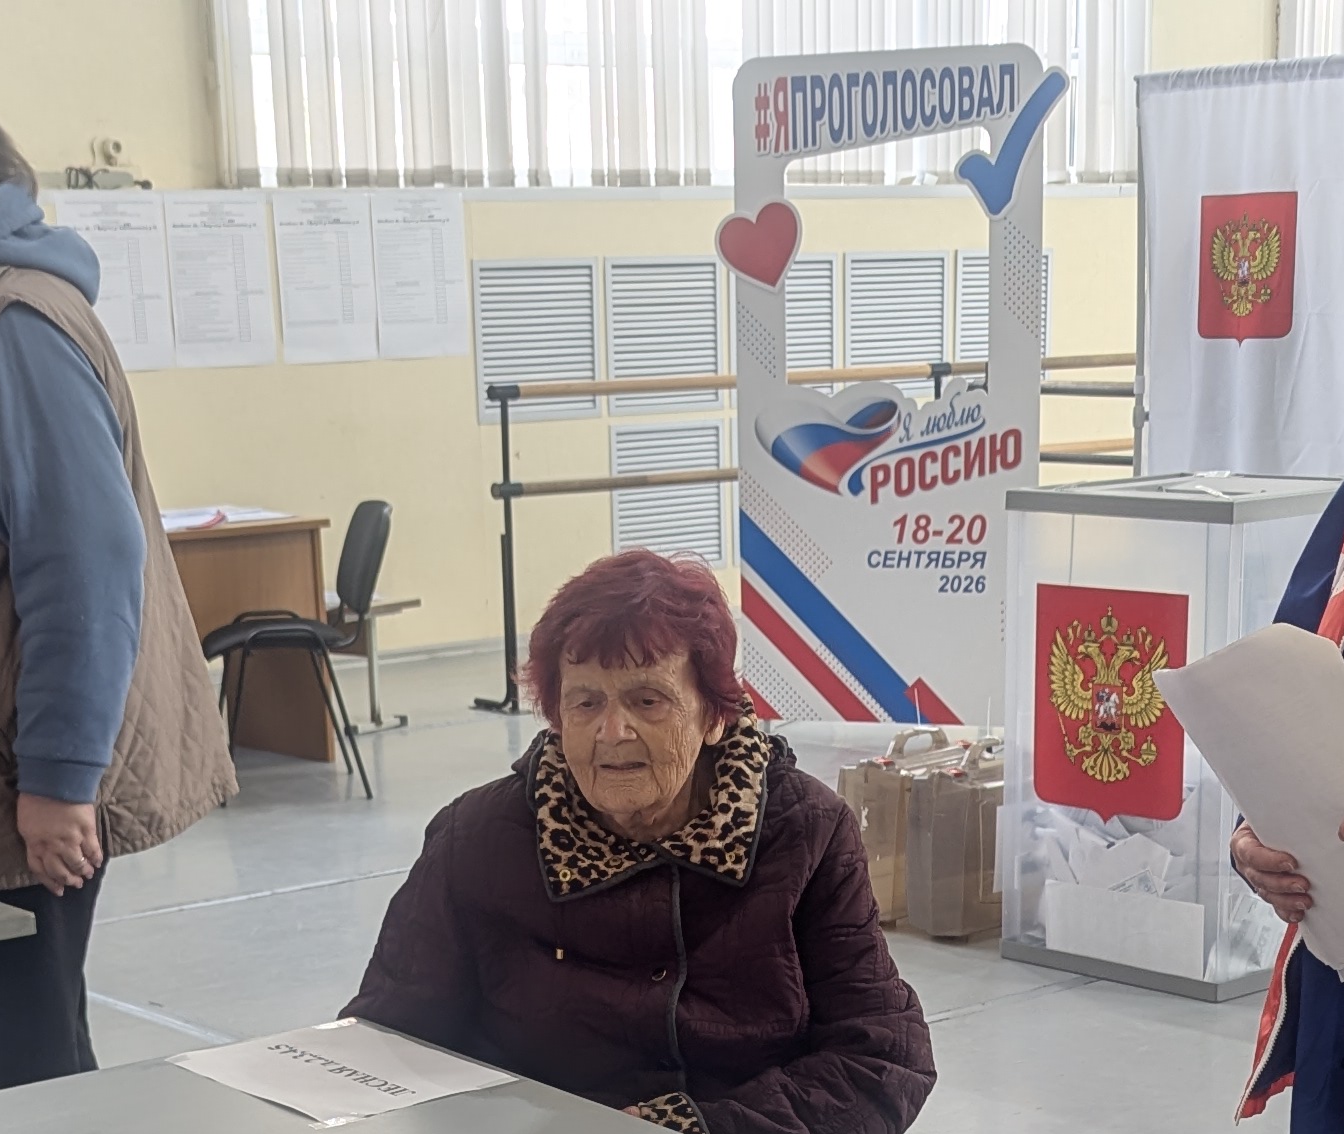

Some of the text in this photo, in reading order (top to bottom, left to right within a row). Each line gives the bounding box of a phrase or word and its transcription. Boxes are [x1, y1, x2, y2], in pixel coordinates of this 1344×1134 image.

[755, 62, 1017, 155] #ЯПРОГОЛОСОВАЛ
[898, 390, 984, 444] Я люблю
[869, 428, 1024, 505] РОССИЮ
[892, 513, 988, 546] 18-20
[867, 549, 987, 571] СЕНТЯБРЯ
[938, 574, 987, 595] 2026
[327, 1065, 417, 1097] ЛЕСНАЯ
